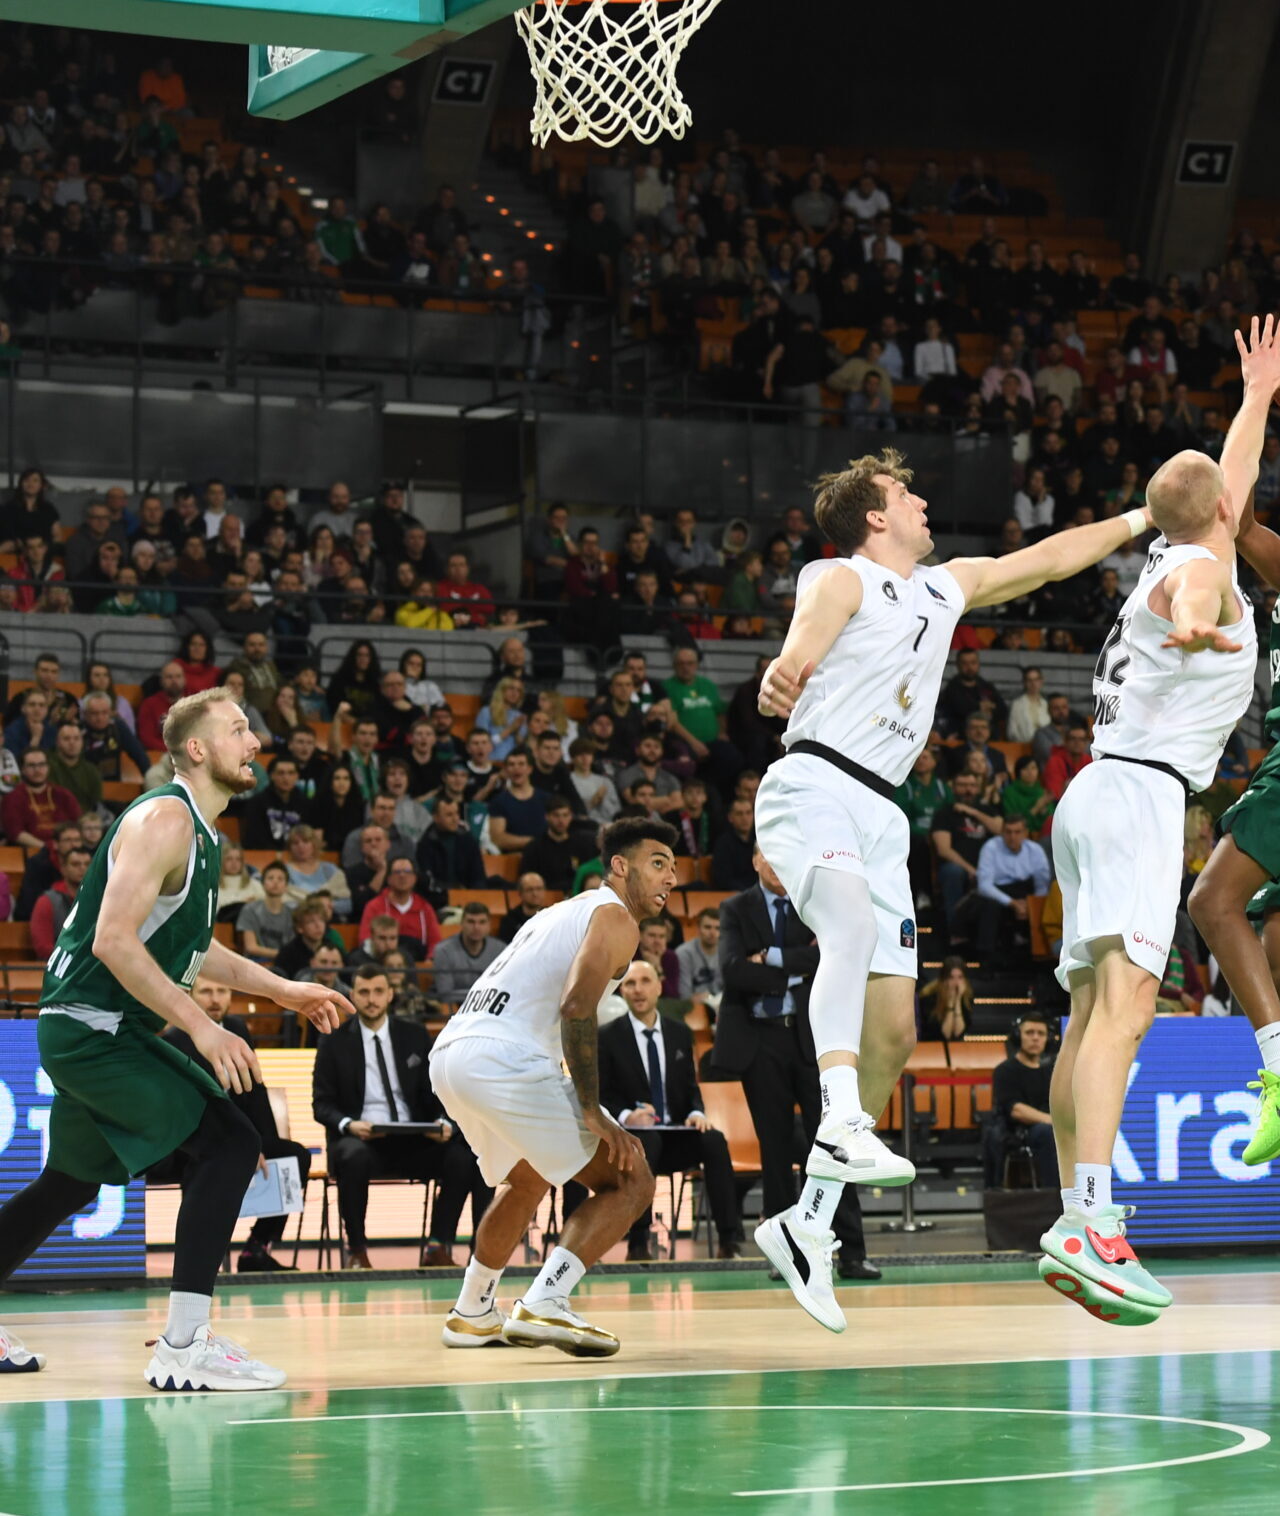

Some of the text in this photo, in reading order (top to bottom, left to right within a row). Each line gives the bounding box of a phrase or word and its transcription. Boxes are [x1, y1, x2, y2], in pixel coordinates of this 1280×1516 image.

[445, 70, 483, 94] C1
[1187, 152, 1225, 175] C1
[912, 614, 929, 654] 7
[1087, 1176, 1096, 1200] CRAFT
[811, 1188, 825, 1213] CRAFT
[554, 1261, 570, 1282] CRAFT
